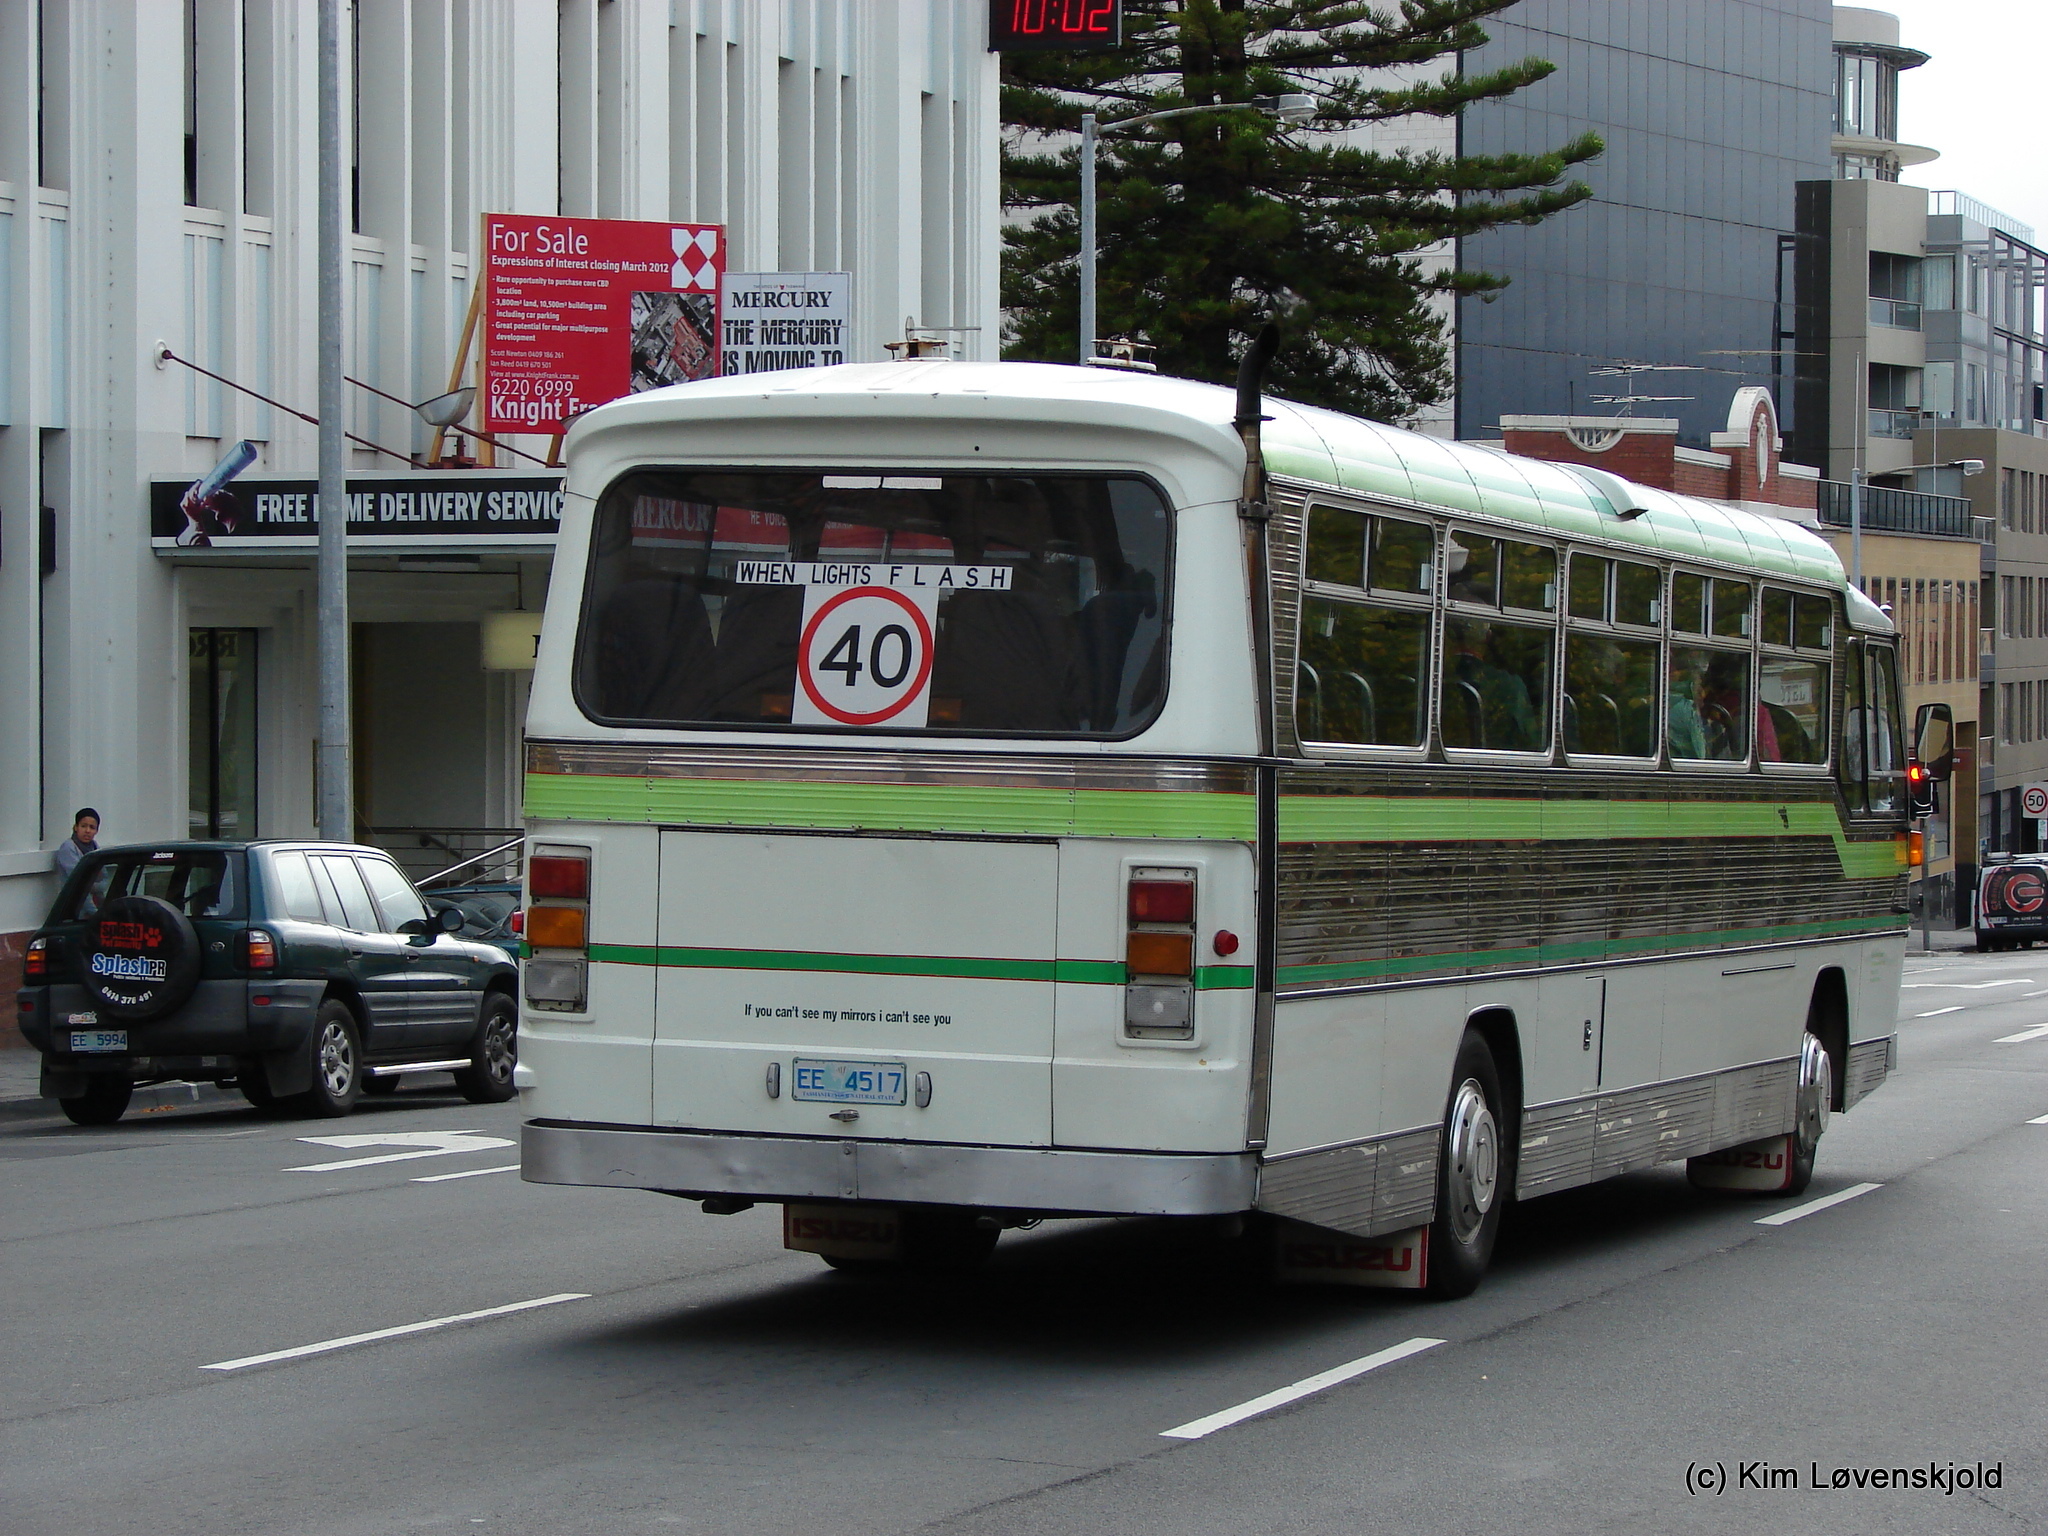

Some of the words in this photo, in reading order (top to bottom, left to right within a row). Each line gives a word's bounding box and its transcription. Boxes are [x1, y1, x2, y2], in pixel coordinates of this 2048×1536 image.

[1012, 0, 1112, 33] 10:02
[492, 223, 530, 252] For
[536, 225, 589, 255] Sale
[492, 255, 545, 268] Expressions
[545, 257, 555, 268] of
[556, 258, 588, 270] Interest
[590, 259, 620, 273] closing
[621, 261, 647, 272] March
[649, 262, 669, 273] 2012
[496, 275, 510, 283] Rare
[511, 276, 547, 286] opportunity
[555, 278, 582, 287] purchase
[497, 286, 522, 295] location
[568, 302, 593, 311] building
[732, 291, 832, 308] MERCURY
[496, 310, 525, 320] including
[537, 312, 560, 321] parking
[495, 321, 513, 329] Great
[514, 322, 541, 331] potential
[542, 323, 550, 331] for
[551, 324, 569, 332] major
[569, 324, 608, 334] multipurpose
[723, 319, 754, 345] THE
[761, 319, 842, 345] MERCURY
[496, 333, 536, 342] development
[490, 349, 505, 357] Scott
[722, 350, 739, 376] IS
[745, 350, 815, 374] MOVING
[491, 378, 530, 395] 6220
[534, 380, 574, 397] 6999
[491, 395, 563, 426] Knight
[256, 493, 308, 523] FREE
[380, 491, 483, 523] DELIVERY
[740, 562, 796, 583] WHEN
[811, 564, 872, 585] LIGHTS
[819, 624, 912, 688] 40
[2028, 795, 2044, 807] 50
[745, 1003, 752, 1016] If
[755, 1006, 772, 1018] you
[775, 1005, 799, 1018] can't
[802, 1009, 820, 1019] see
[823, 1010, 838, 1022] my
[840, 1008, 876, 1022] mirrors
[879, 1010, 883, 1022] i
[885, 1010, 910, 1023] can't
[913, 1014, 930, 1024] see
[933, 1014, 952, 1027] you
[72, 1034, 87, 1047] EE
[96, 1034, 127, 1046] 5994
[797, 1068, 825, 1090] EE
[844, 1070, 902, 1093] 4517
[793, 1217, 896, 1244] ISUZU
